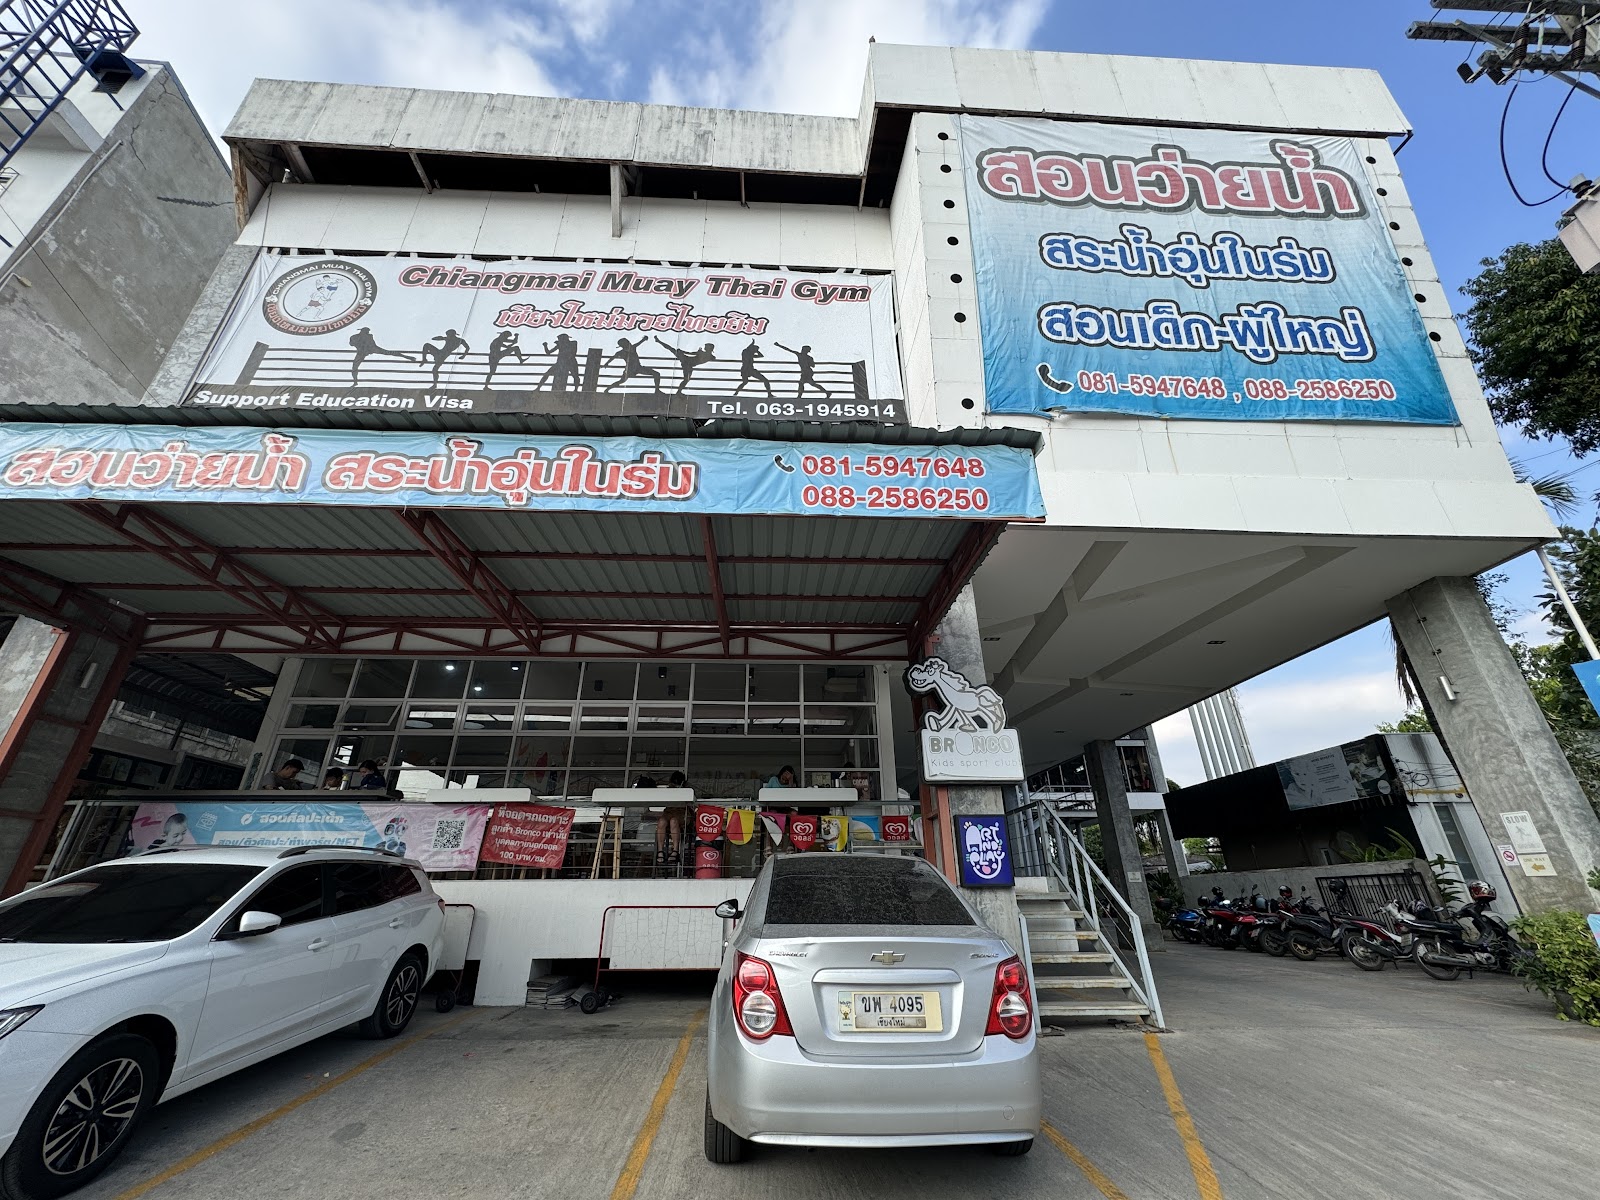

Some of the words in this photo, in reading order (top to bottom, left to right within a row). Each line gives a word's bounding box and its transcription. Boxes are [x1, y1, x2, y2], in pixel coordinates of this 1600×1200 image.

[981, 142, 1360, 214] สอนว่ายน้ำ
[1041, 226, 1333, 286] สระน้ำอุ่นในร่ม
[273, 265, 319, 296] CHIANGMAI
[321, 263, 351, 271] MUAY
[399, 265, 596, 294] Chiangmai
[597, 271, 700, 299] Muay
[705, 275, 787, 300] Thai
[791, 279, 872, 305] Gym
[494, 299, 769, 335] เชียงใหม่มวยไทยยิม
[1041, 300, 1374, 363] สอนเด็ก-ผู้ใหญ่
[1077, 370, 1226, 399] 081-5947648
[1244, 378, 1396, 401] 088-2586250
[193, 390, 290, 408] Support
[295, 391, 416, 409] Education
[423, 395, 474, 410] Visa
[707, 400, 749, 415] Tel.
[755, 402, 896, 418] 063-1945914
[3, 433, 305, 493] สอนว่ายน้ำ
[326, 435, 698, 505] สระน้ำอุ่นในร่ม
[802, 454, 986, 479] 081-5947648
[802, 485, 990, 511] 088-2586250
[931, 759, 954, 767] Kids
[960, 759, 988, 768] sport
[994, 759, 1018, 767] club
[498, 803, 569, 825] ที่จอดรถเฉพาะ
[1505, 815, 1528, 824] SLOW
[515, 825, 541, 837] Bronco
[500, 851, 514, 859] 100
[889, 996, 923, 1013] 4095
